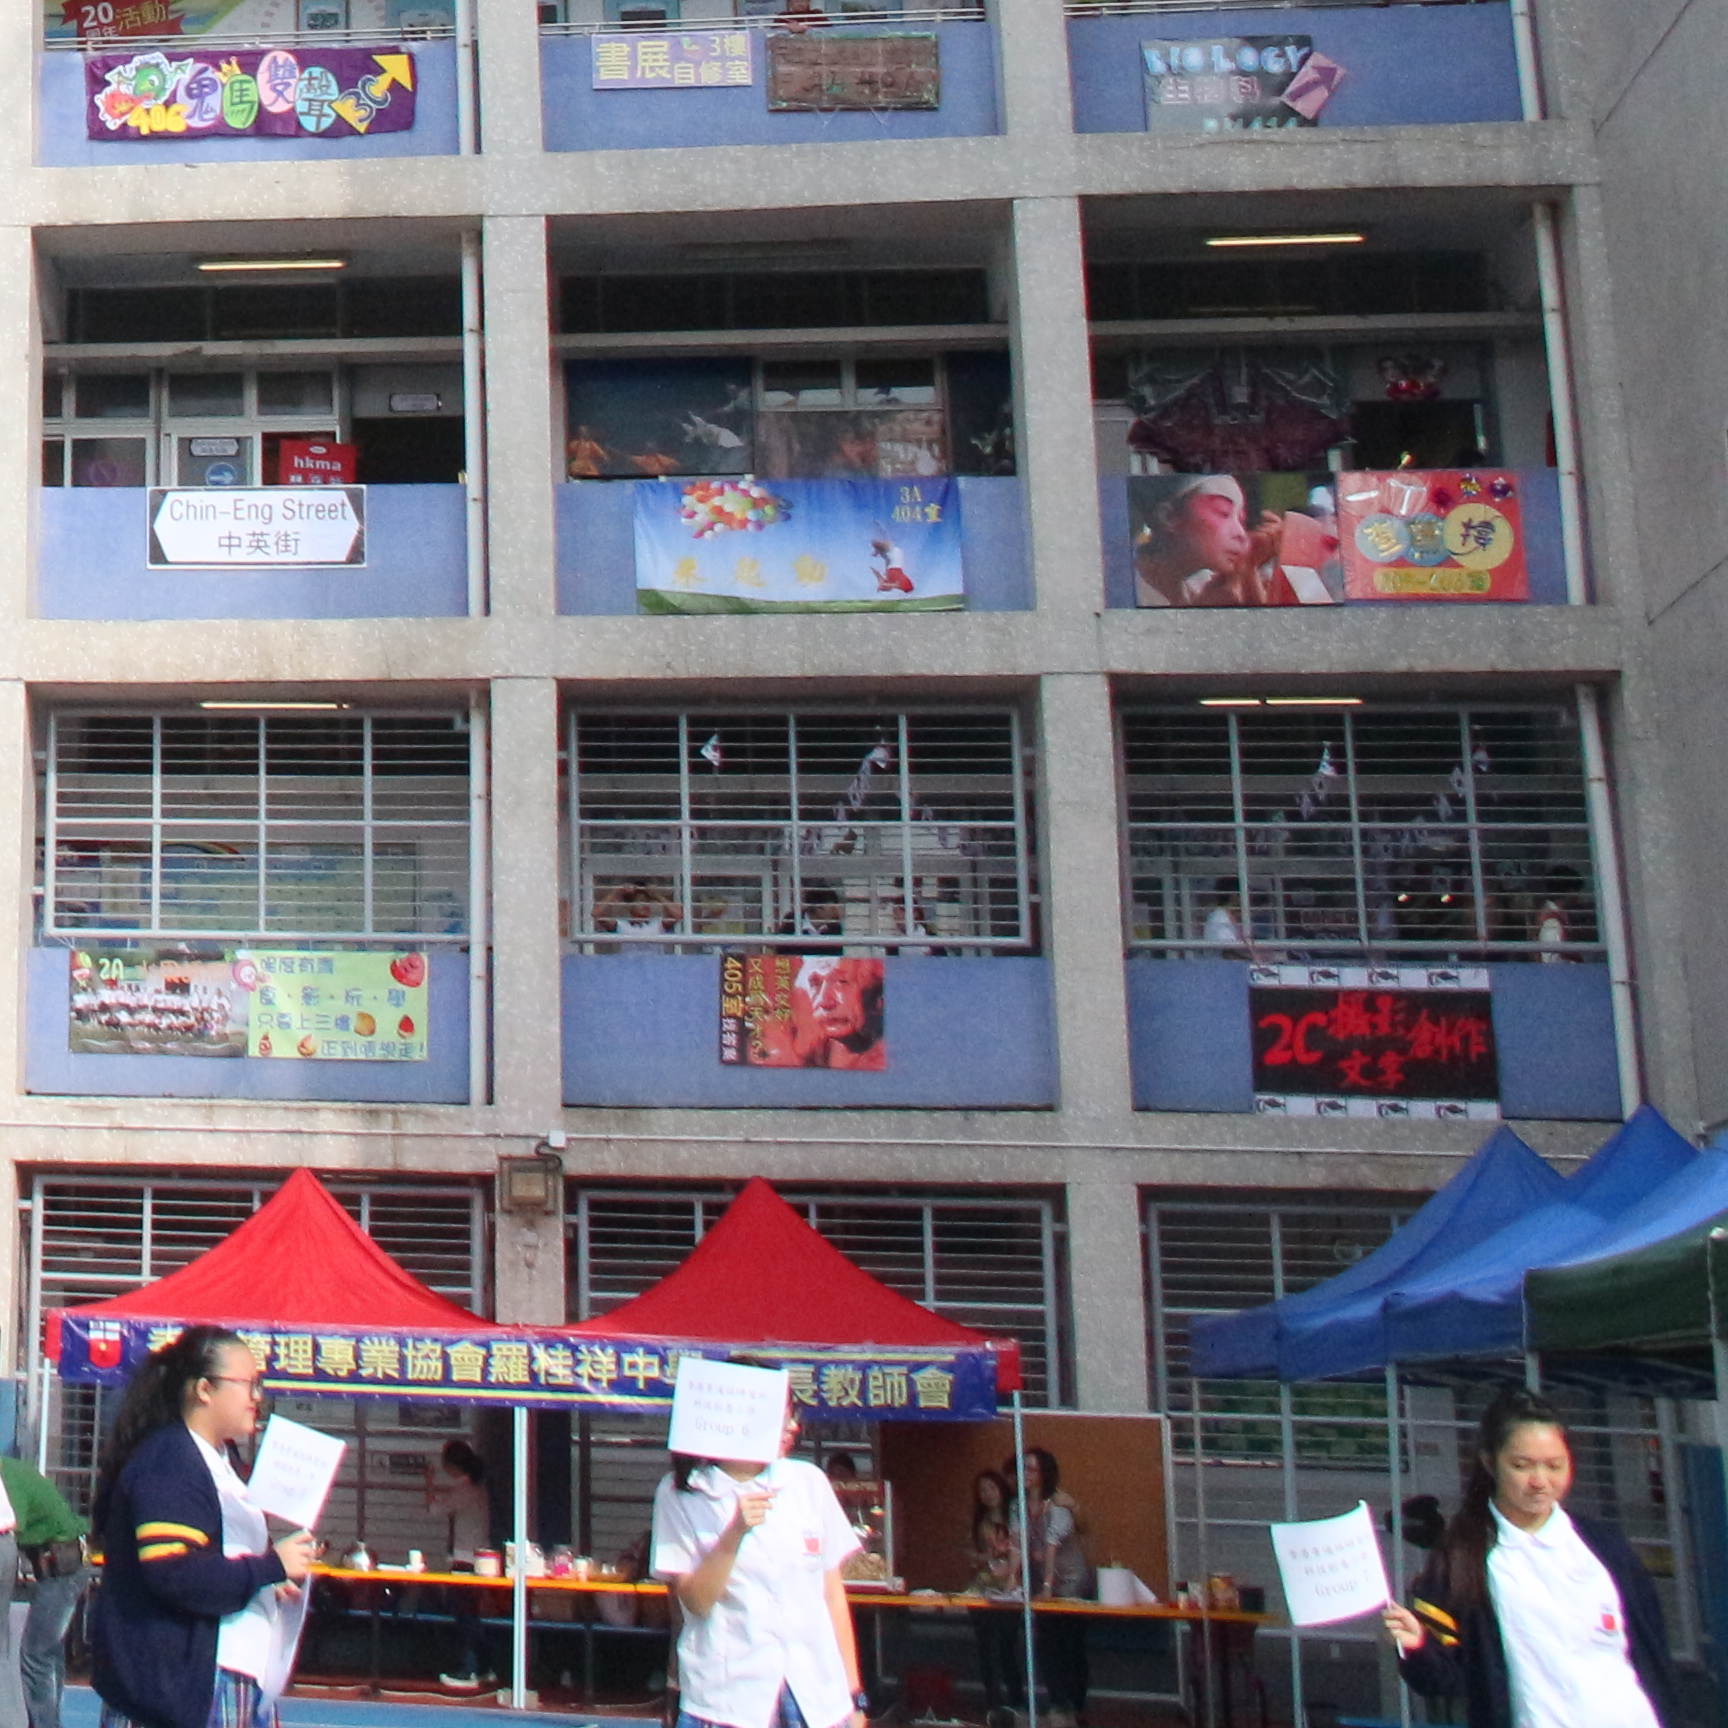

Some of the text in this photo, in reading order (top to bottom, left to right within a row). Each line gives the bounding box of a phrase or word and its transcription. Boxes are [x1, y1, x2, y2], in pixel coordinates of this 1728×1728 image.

[596, 42, 671, 80] 書展
[127, 103, 188, 135] 406
[294, 456, 341, 471] hkma
[282, 498, 348, 521] Street
[218, 530, 301, 556] 中英街
[1257, 1012, 1328, 1065] 2C
[780, 1363, 954, 1409] 長教師會
[695, 1416, 734, 1436] Group
[1315, 1579, 1358, 1597] Group
